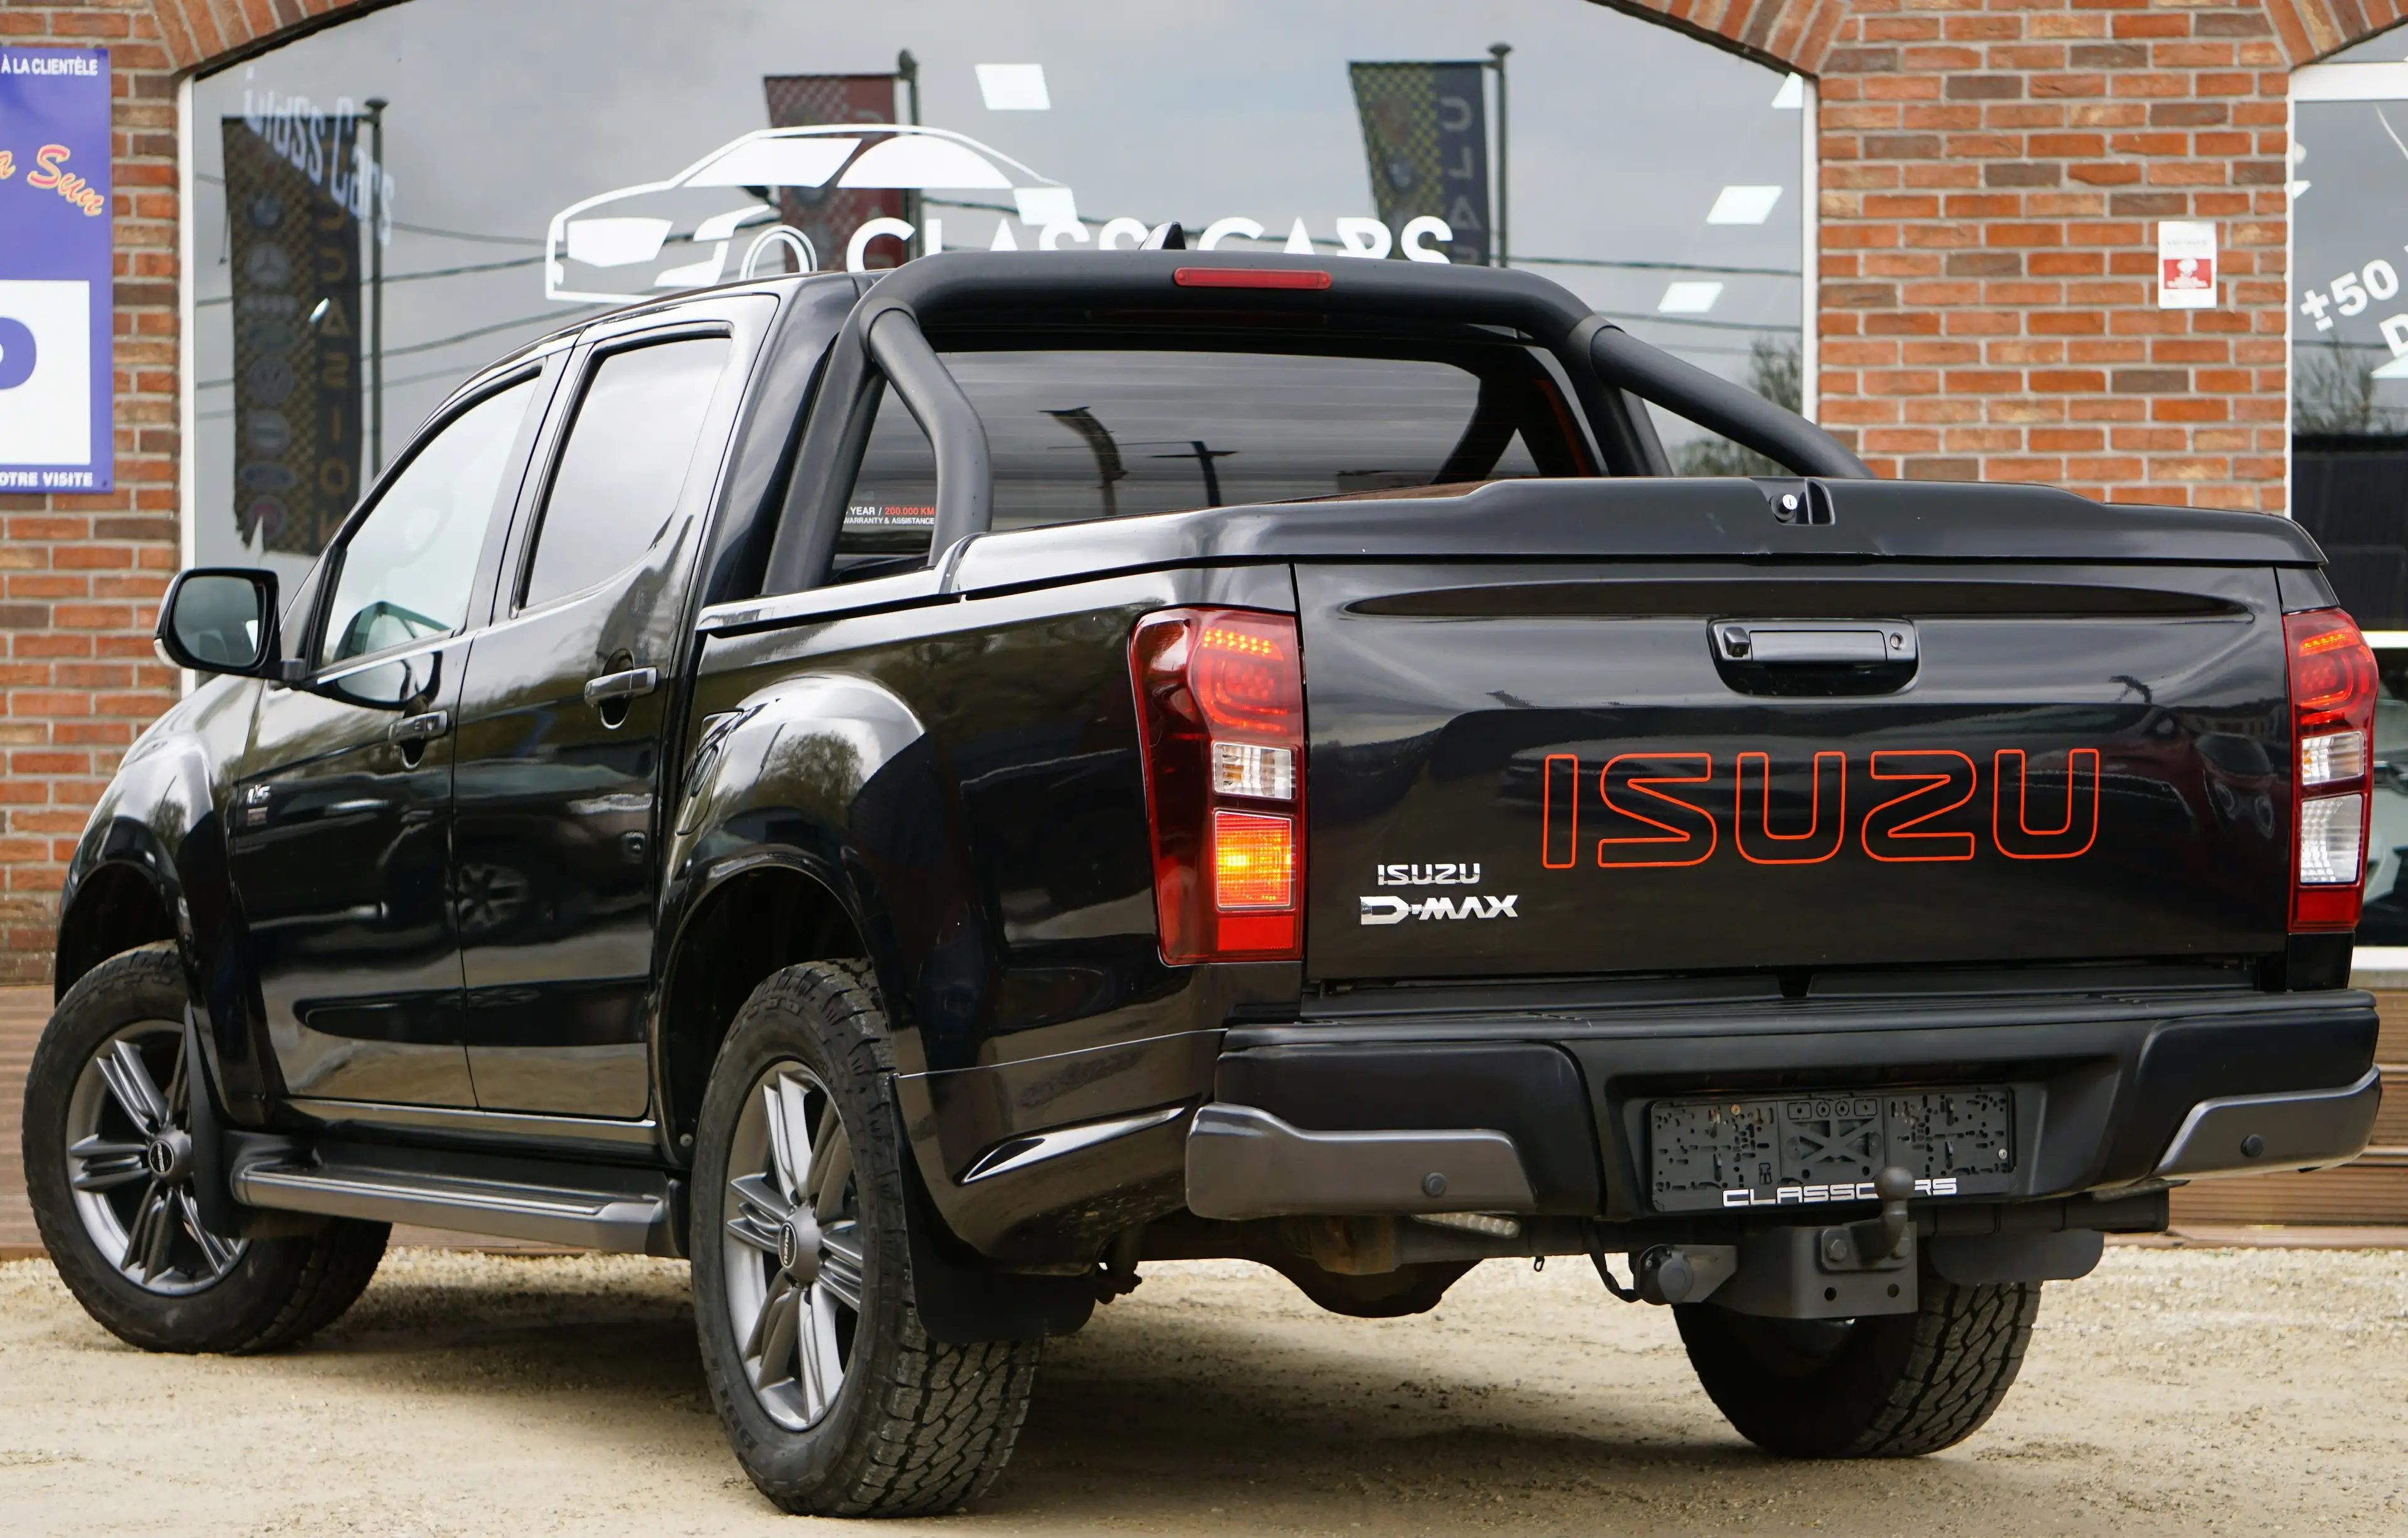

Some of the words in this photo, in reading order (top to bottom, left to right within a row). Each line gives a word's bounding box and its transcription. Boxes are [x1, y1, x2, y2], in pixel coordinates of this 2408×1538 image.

[13, 57, 31, 74] LA
[31, 56, 98, 76] CLIENTÈLE
[0, 471, 38, 487] OTRE
[43, 471, 93, 487] VISITE
[850, 507, 875, 515] YEAR
[885, 507, 919, 515] 200.000
[921, 507, 934, 515] KM
[891, 517, 935, 525] ASSISTANCE
[1543, 749, 2100, 869] ISUZU
[1377, 863, 1481, 885] ISUZU
[1359, 895, 1519, 925] D-MAX
[1723, 1177, 1957, 1207] CLASSCRS
